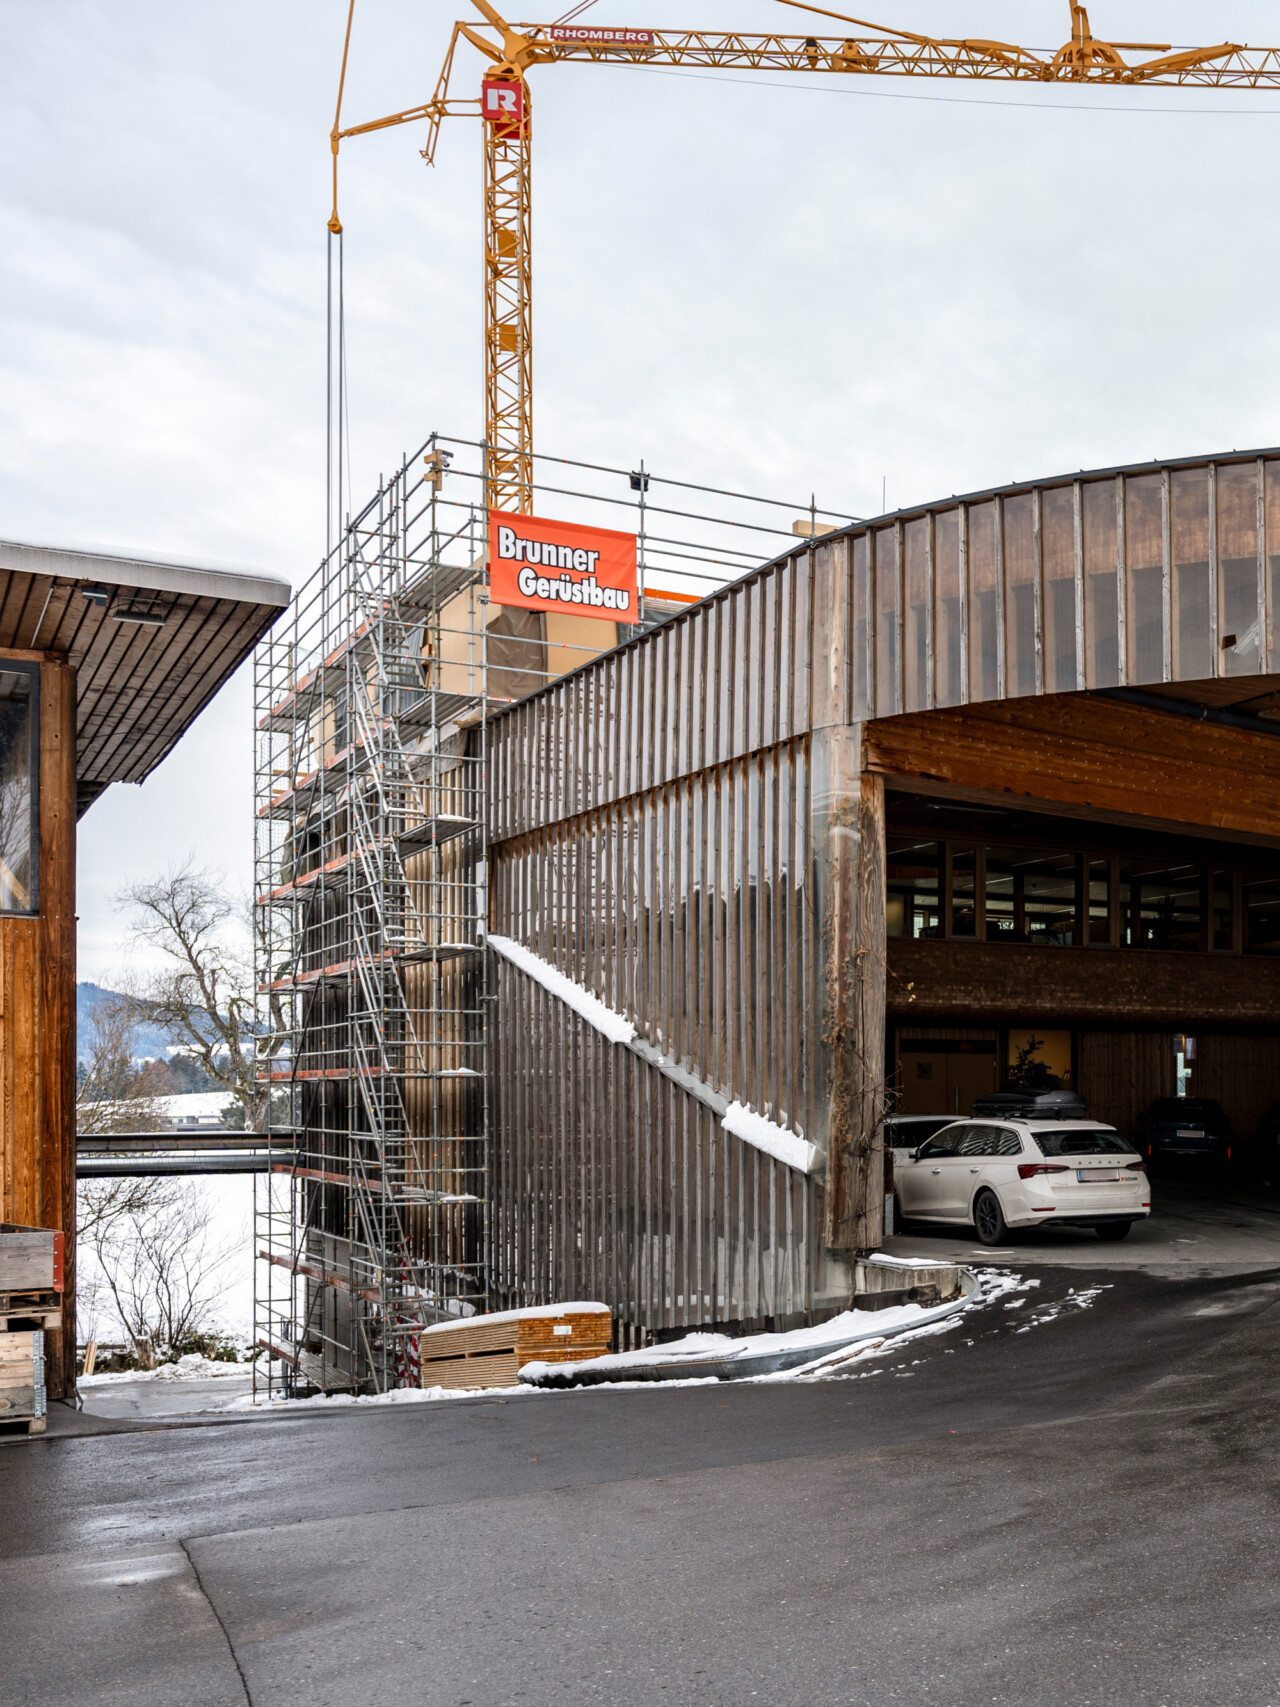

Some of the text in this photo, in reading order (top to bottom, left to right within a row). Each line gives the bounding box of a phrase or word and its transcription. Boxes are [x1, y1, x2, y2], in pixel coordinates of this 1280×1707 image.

[553, 28, 649, 42] RHOMBERG
[486, 88, 518, 112] R
[498, 525, 600, 573] Brunner
[518, 566, 630, 611] Gerüstbau
